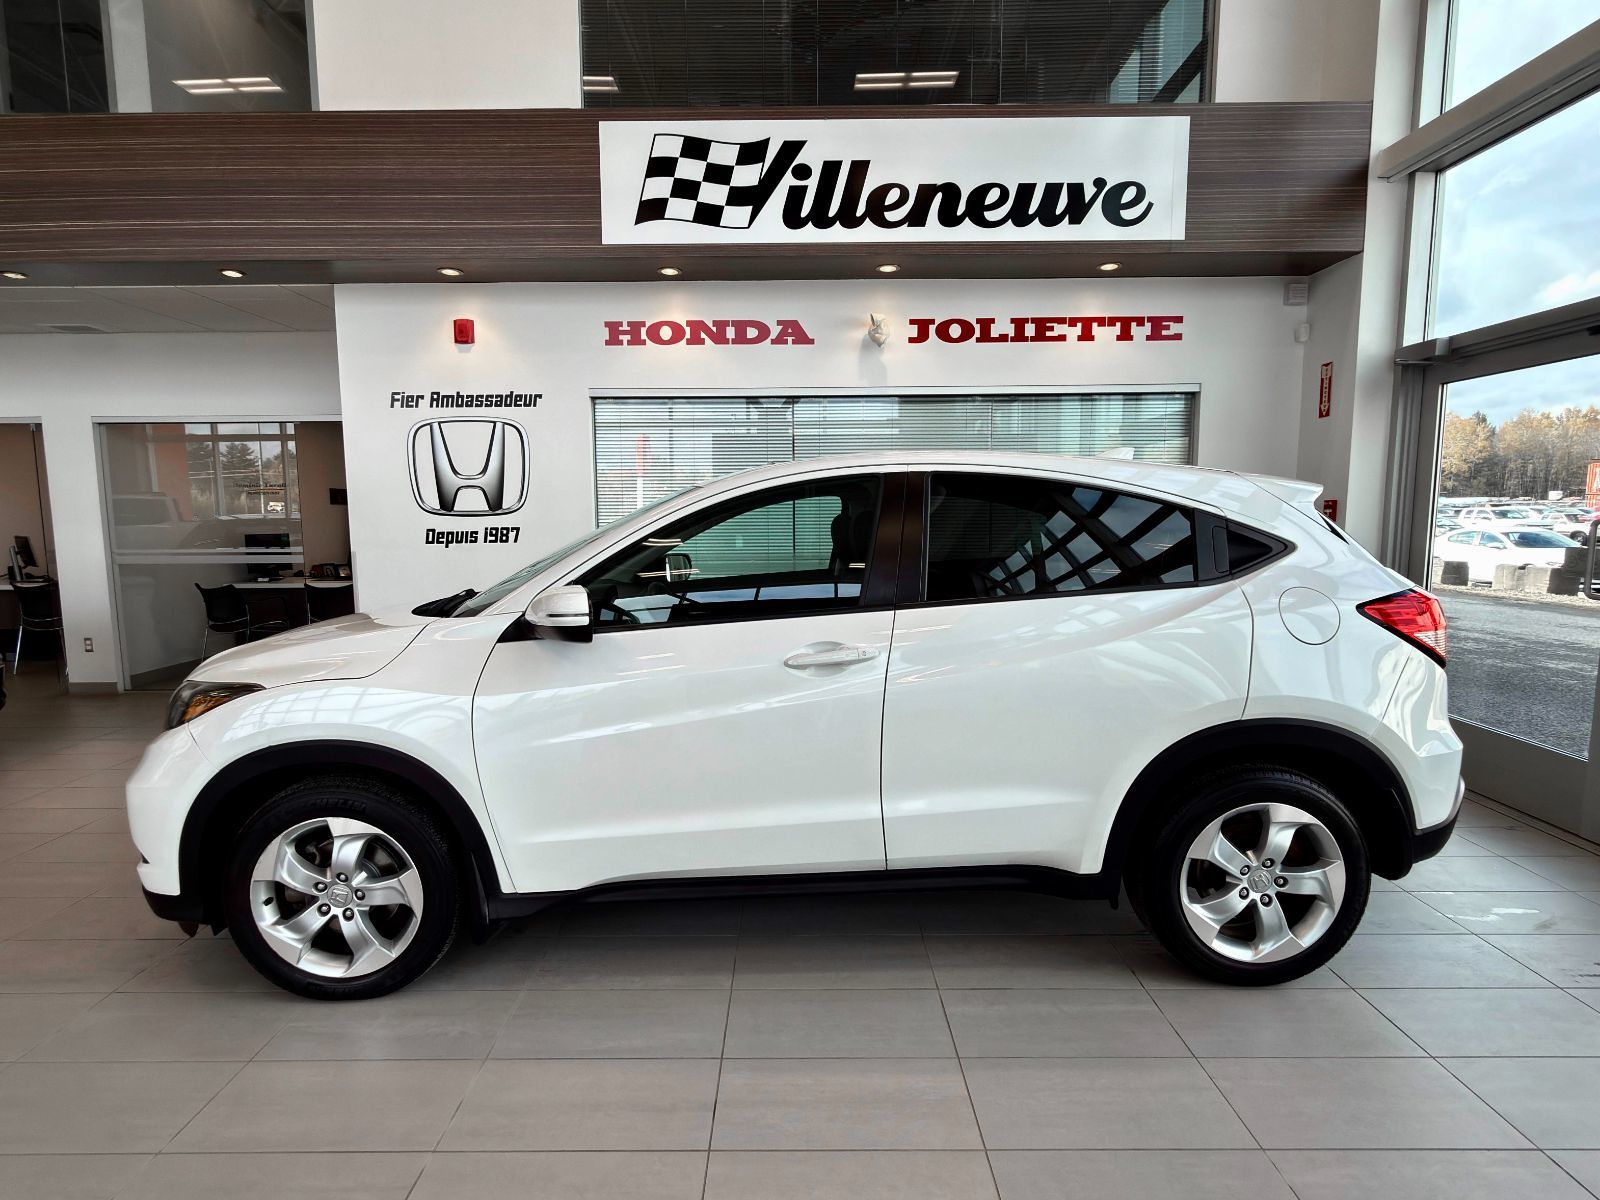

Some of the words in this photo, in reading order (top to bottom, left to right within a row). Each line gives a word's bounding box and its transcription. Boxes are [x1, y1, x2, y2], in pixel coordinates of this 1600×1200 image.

[746, 138, 1154, 230] Villeneuve
[605, 319, 815, 346] HONDA
[908, 315, 1184, 345] JOLIETTE
[390, 391, 425, 408] Fier
[429, 391, 543, 409] Ambassadeur
[425, 528, 479, 548] Depuis
[483, 526, 521, 544] 1987
